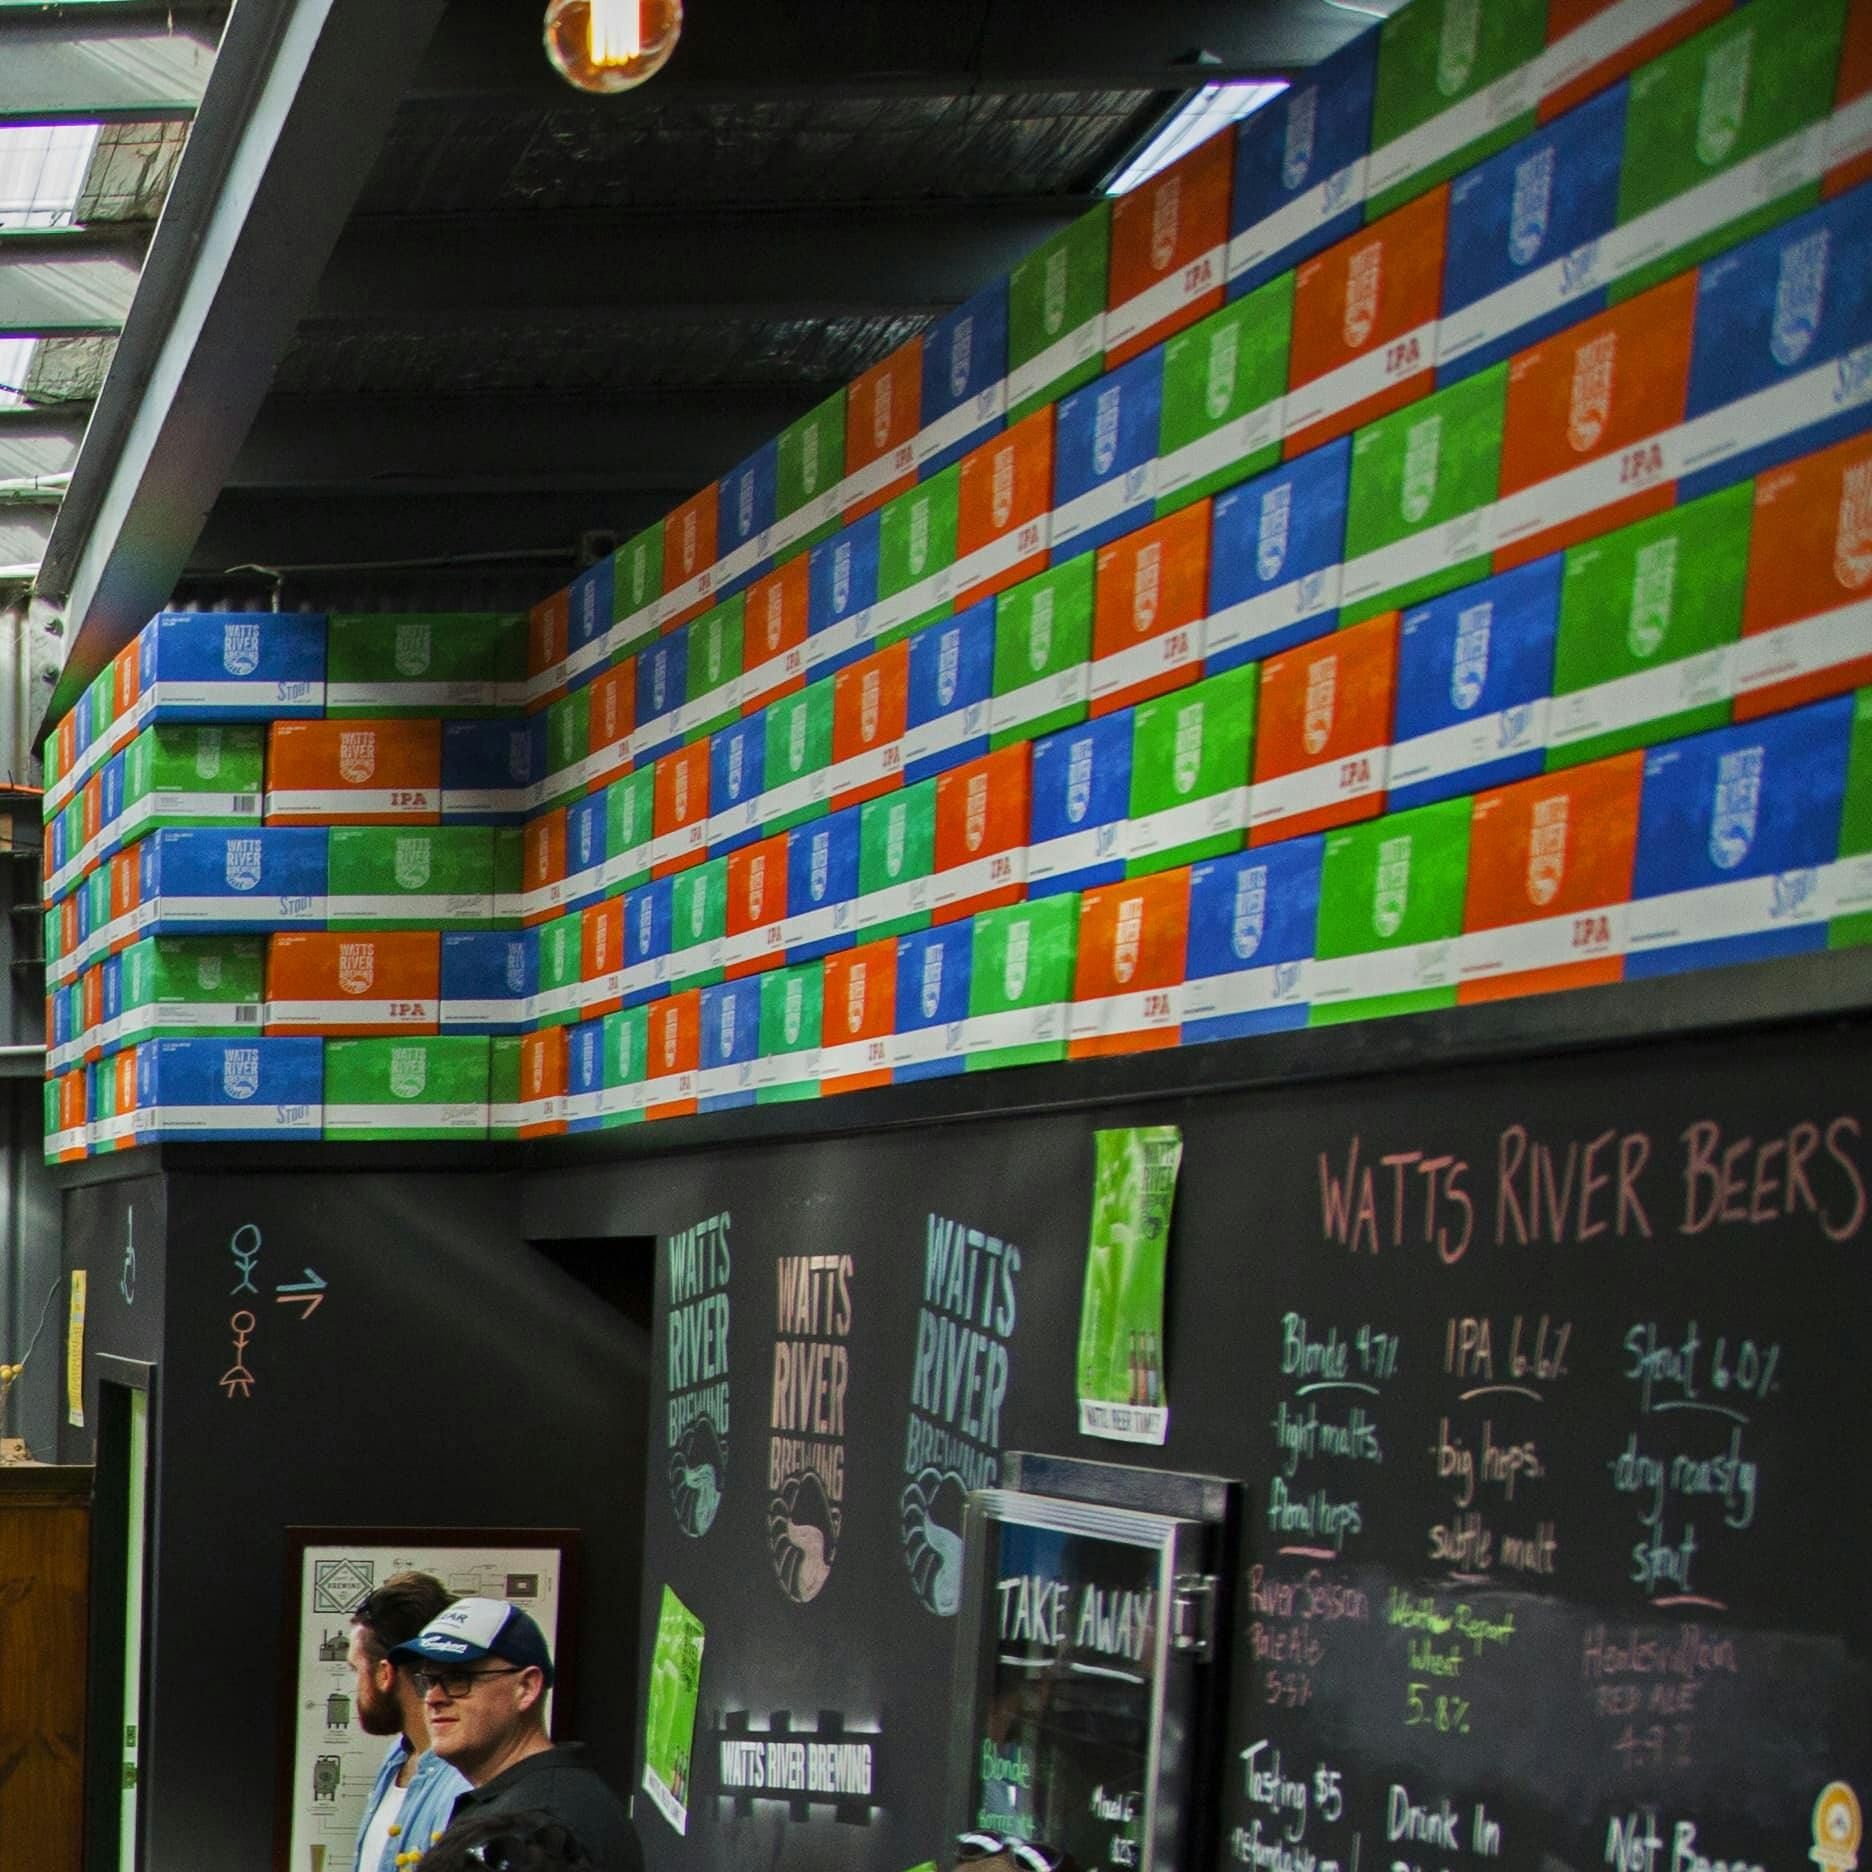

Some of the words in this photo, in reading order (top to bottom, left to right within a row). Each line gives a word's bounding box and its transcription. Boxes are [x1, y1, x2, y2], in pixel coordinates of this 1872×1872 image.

[391, 793, 427, 806] IPA
[390, 1003, 425, 1016] IPA
[1319, 1134, 1474, 1264] WATTS
[1495, 1124, 1652, 1245] RIVER
[1678, 1117, 1867, 1241] BEERS
[669, 1211, 731, 1304] WATTS
[777, 1254, 853, 1336] WATTS
[925, 1213, 1021, 1338] WATTS
[669, 1293, 729, 1392] RIVER
[912, 1307, 1009, 1448] RIVER
[1281, 1311, 1347, 1379] Blonde
[1444, 1317, 1493, 1380] IPA
[771, 1342, 848, 1436] RIVER
[998, 1577, 1068, 1645] TAKE
[1076, 1583, 1153, 1661] AWAY
[720, 1741, 764, 1787] WATTS
[767, 1742, 805, 1790] RIVER
[808, 1743, 872, 1795] BREWING
[1313, 1761, 1342, 1822] $5
[1387, 1784, 1459, 1850] Drink
[1473, 1803, 1500, 1856] In
